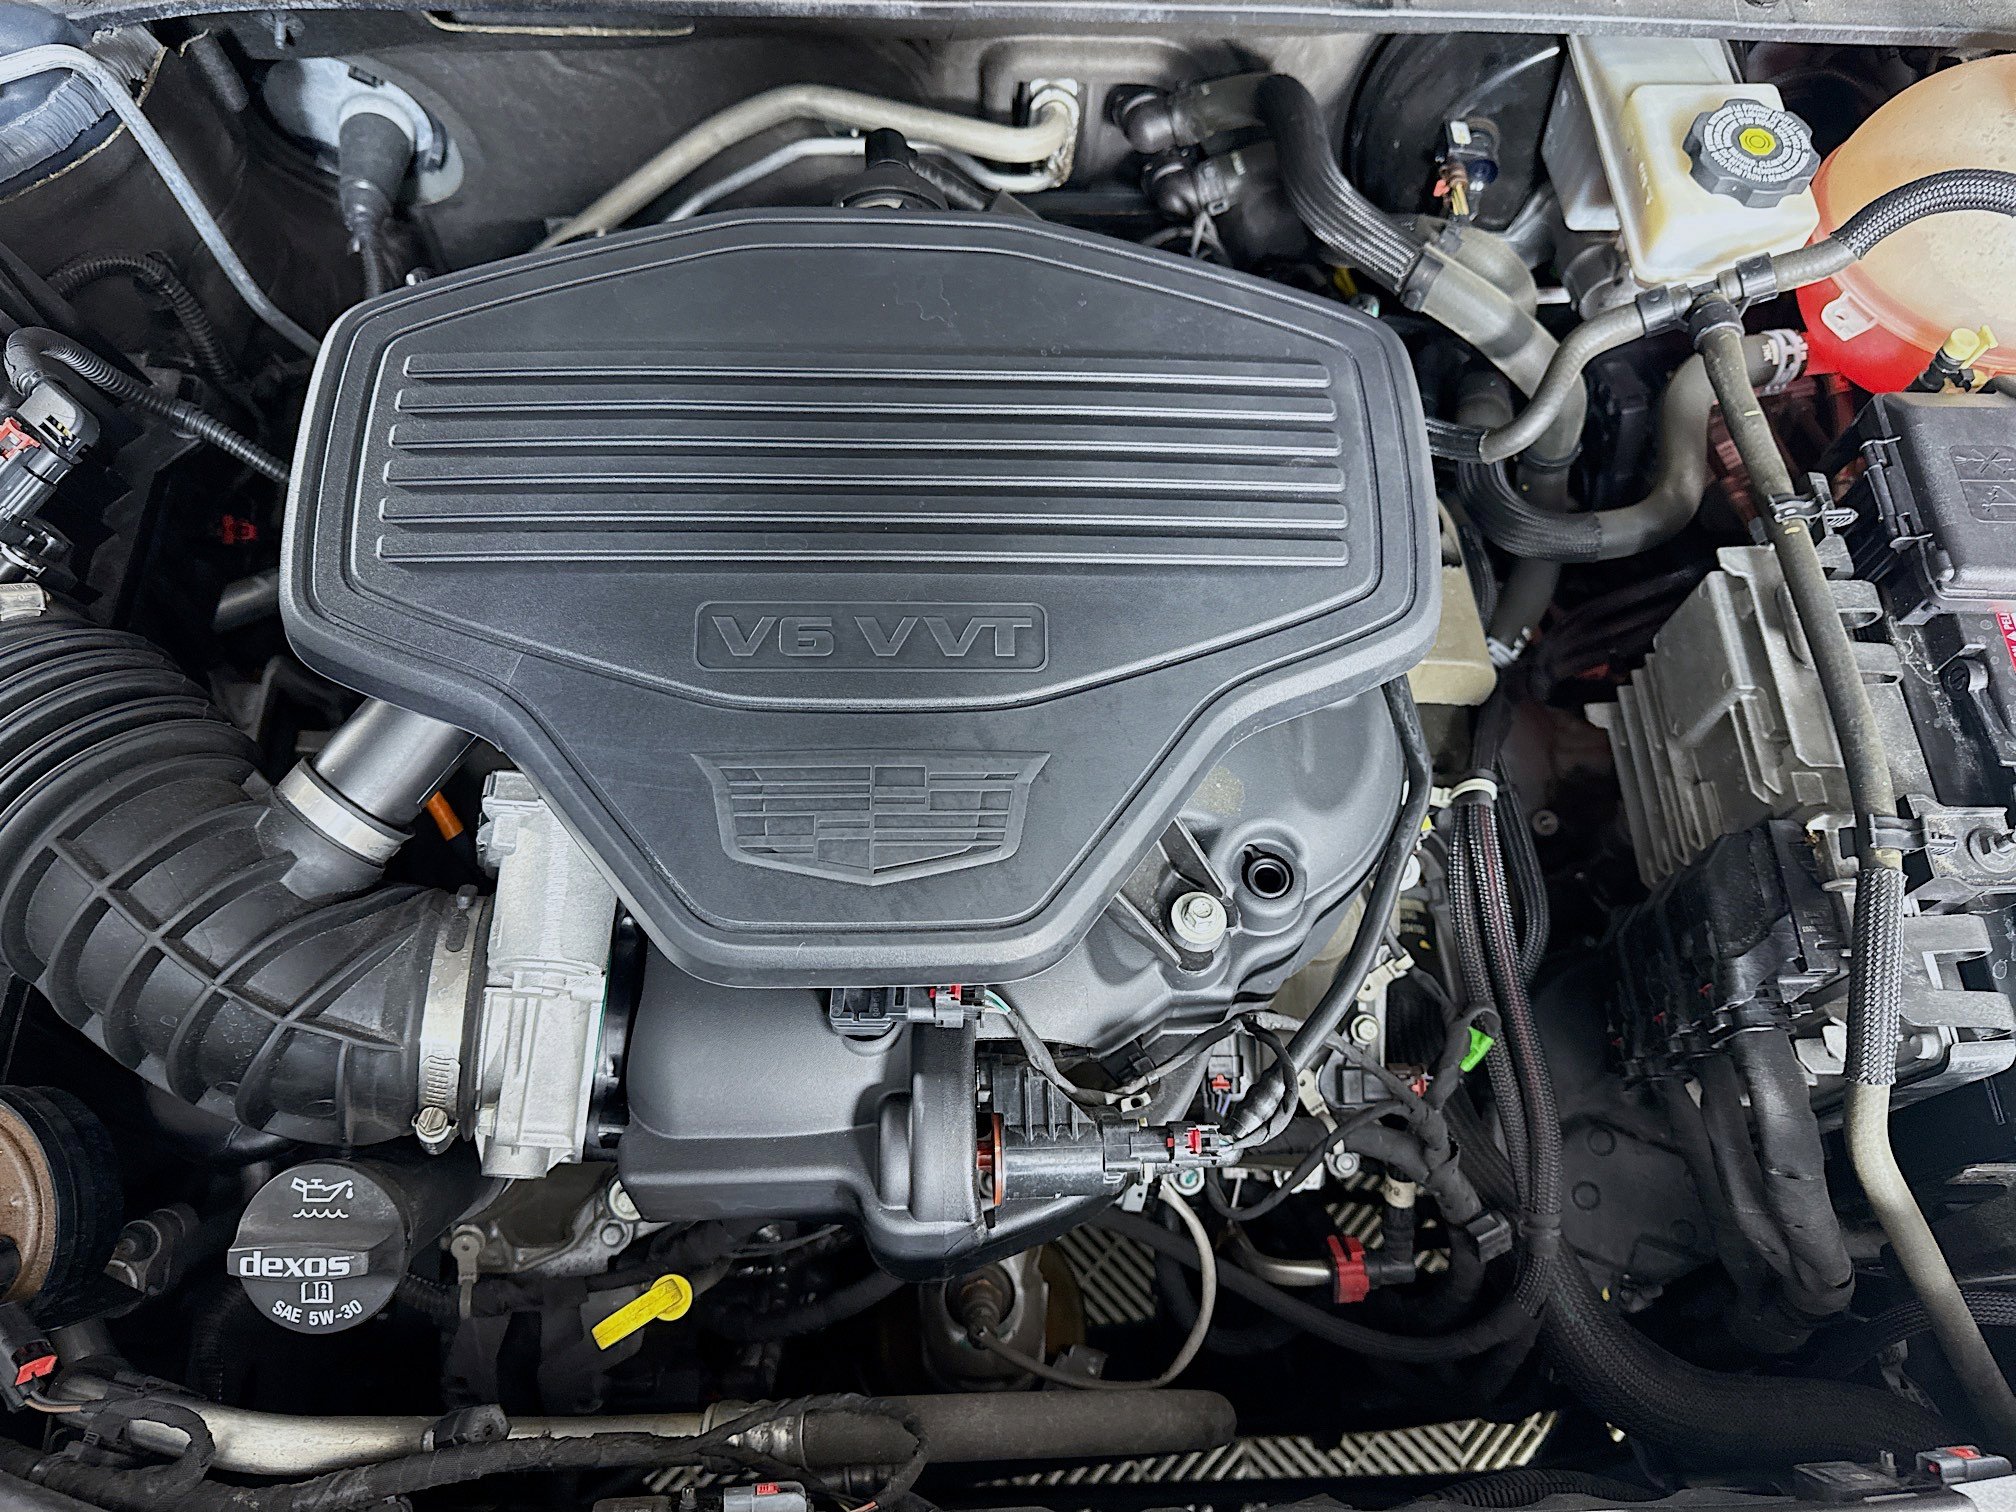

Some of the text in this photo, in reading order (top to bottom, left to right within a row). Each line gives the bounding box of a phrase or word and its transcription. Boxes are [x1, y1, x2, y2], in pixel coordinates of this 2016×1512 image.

[712, 616, 1032, 656] V6 VVT
[239, 1251, 351, 1277] dexos
[272, 1300, 363, 1326] SAE 5W-30
